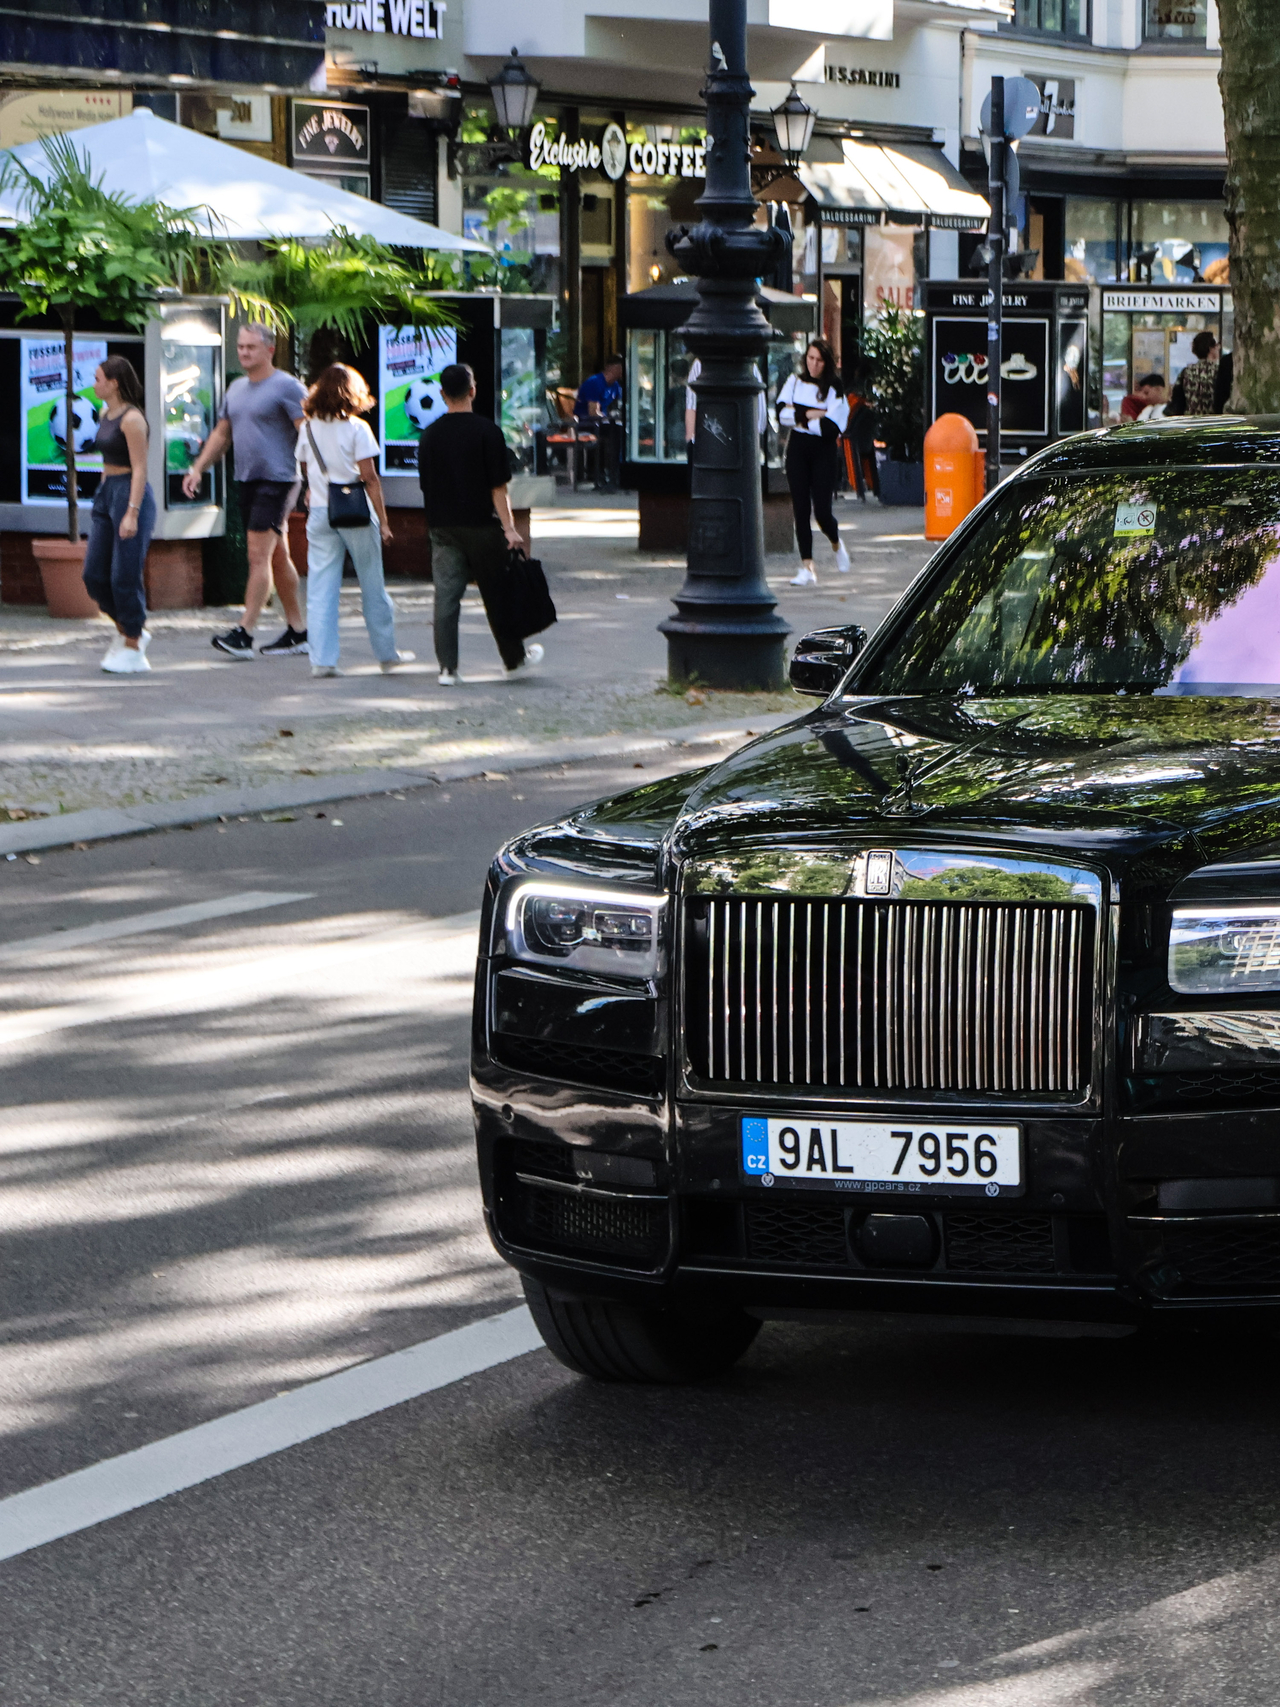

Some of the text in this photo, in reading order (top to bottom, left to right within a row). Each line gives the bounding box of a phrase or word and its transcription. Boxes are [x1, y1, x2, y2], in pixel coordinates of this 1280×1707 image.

[388, 0, 447, 39] WELT
[824, 65, 900, 88] ESSARINI
[530, 121, 602, 173] Exclusive
[821, 209, 876, 224] BALDESSARINI
[931, 216, 981, 229] BALDESSARINI
[876, 285, 913, 310] SALE
[952, 294, 975, 306] FINE
[1107, 295, 1217, 309] BRIEFMARKEN
[778, 1127, 998, 1177] 9AL 7956
[747, 1155, 766, 1169] CZ
[834, 1179, 921, 1192] www.gpcars.cz
